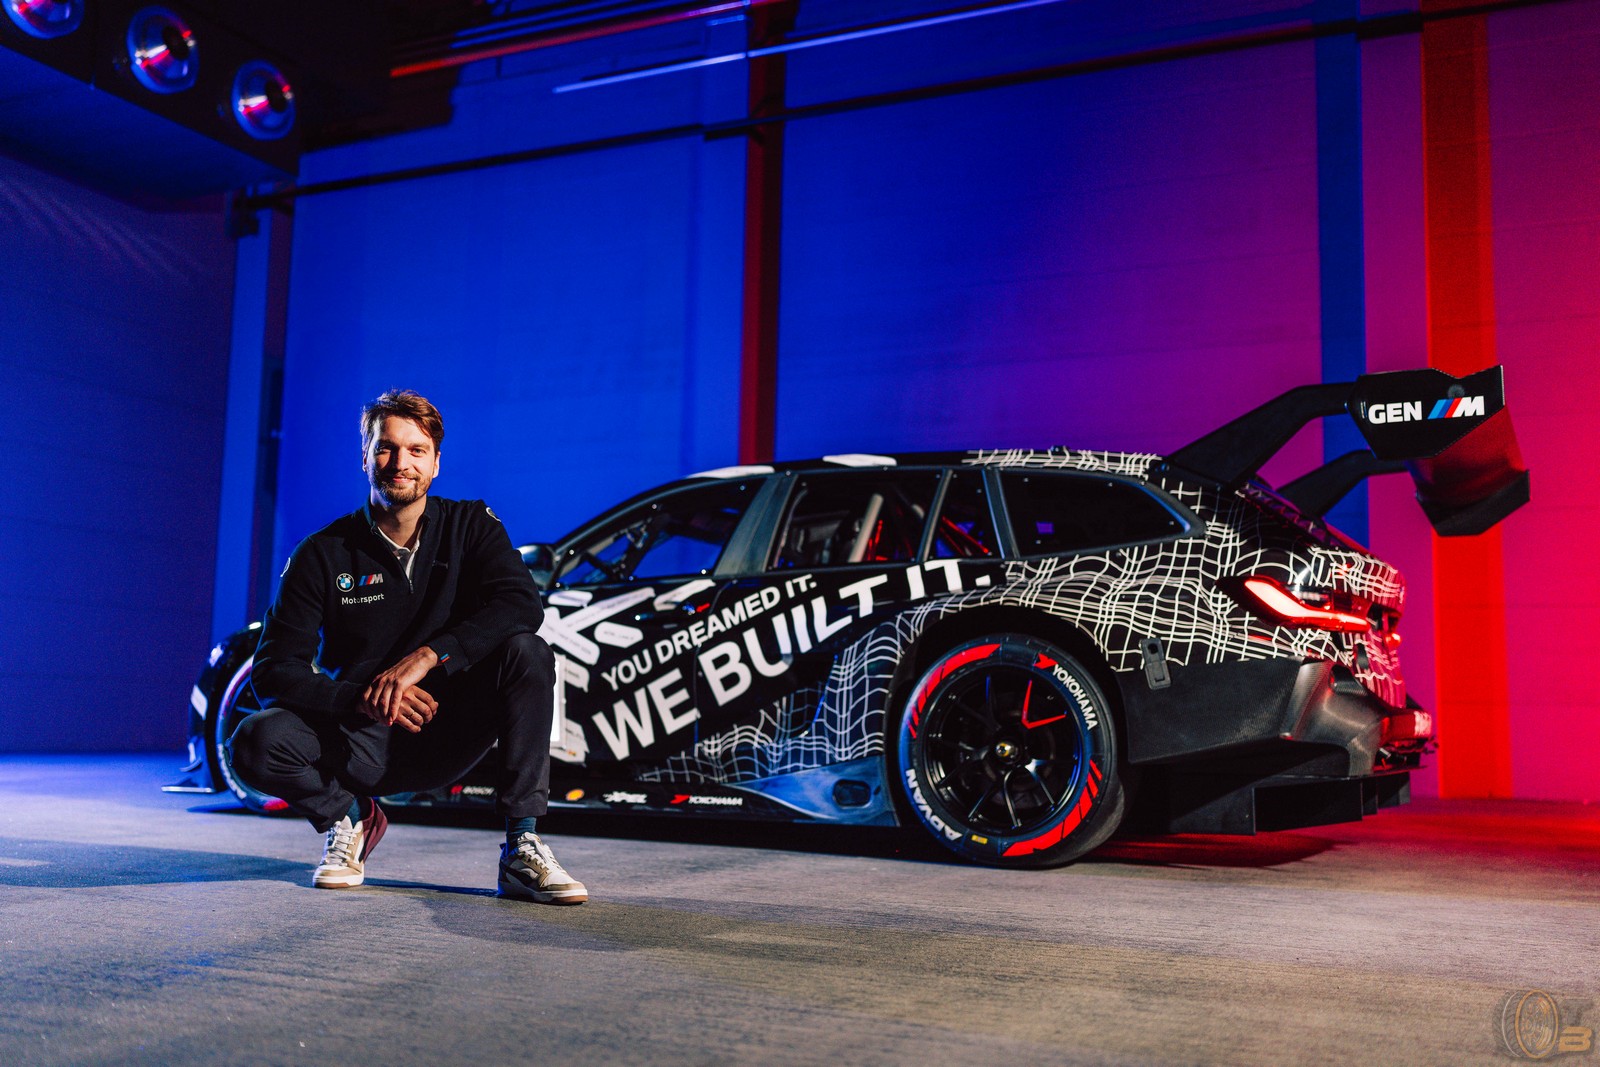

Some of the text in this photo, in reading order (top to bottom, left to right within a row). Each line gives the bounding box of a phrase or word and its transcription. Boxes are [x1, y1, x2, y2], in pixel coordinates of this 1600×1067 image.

[1368, 401, 1422, 425] GEN
[341, 592, 385, 605] Motorsport
[601, 648, 653, 691] YOU
[655, 586, 780, 664] DREAMED
[785, 573, 817, 598] IT.
[591, 667, 701, 761] WE
[698, 573, 888, 707] BUILT
[906, 558, 991, 600] IT.
[1052, 663, 1099, 731] YOKOHAMA
[905, 768, 963, 841] ADVAN
